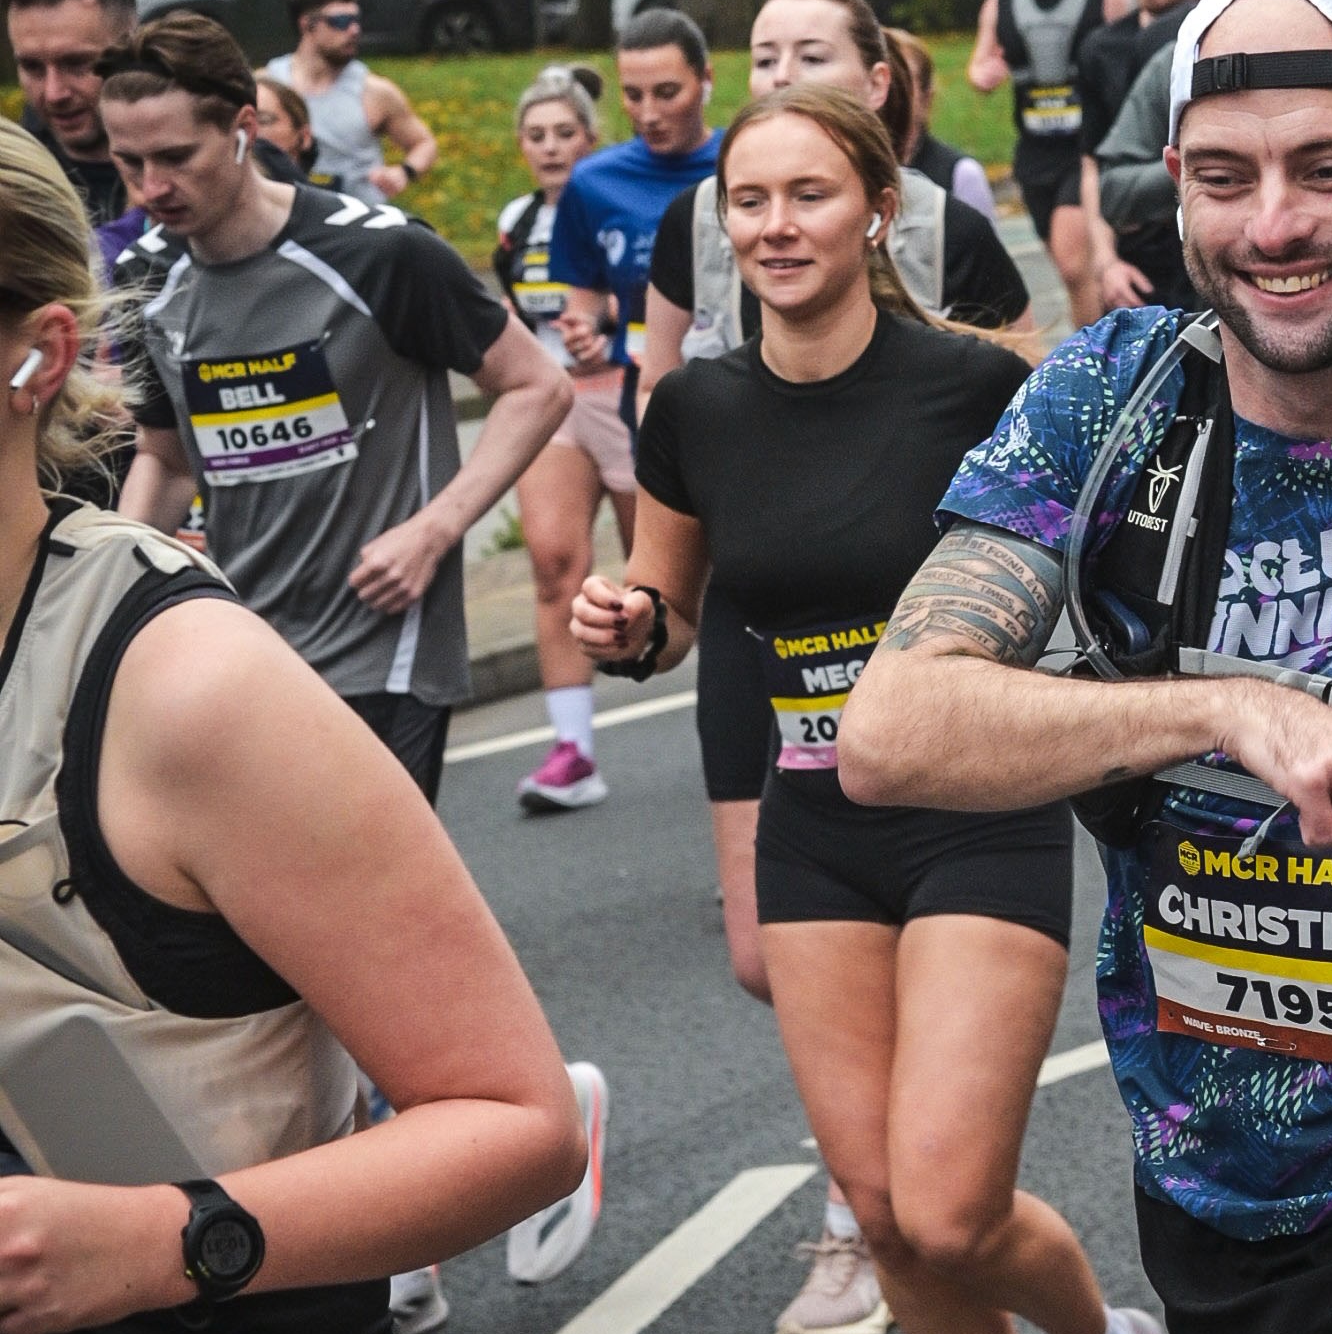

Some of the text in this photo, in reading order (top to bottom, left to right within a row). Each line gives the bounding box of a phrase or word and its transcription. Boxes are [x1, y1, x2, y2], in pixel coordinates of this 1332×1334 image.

[249, 353, 296, 375] HALF
[219, 383, 285, 410] BELL
[217, 417, 313, 451] 10646
[786, 636, 830, 657] MCR
[831, 622, 887, 650] HALF
[1204, 850, 1279, 882] MCR
[1216, 1025, 1261, 1038] BRONZE
